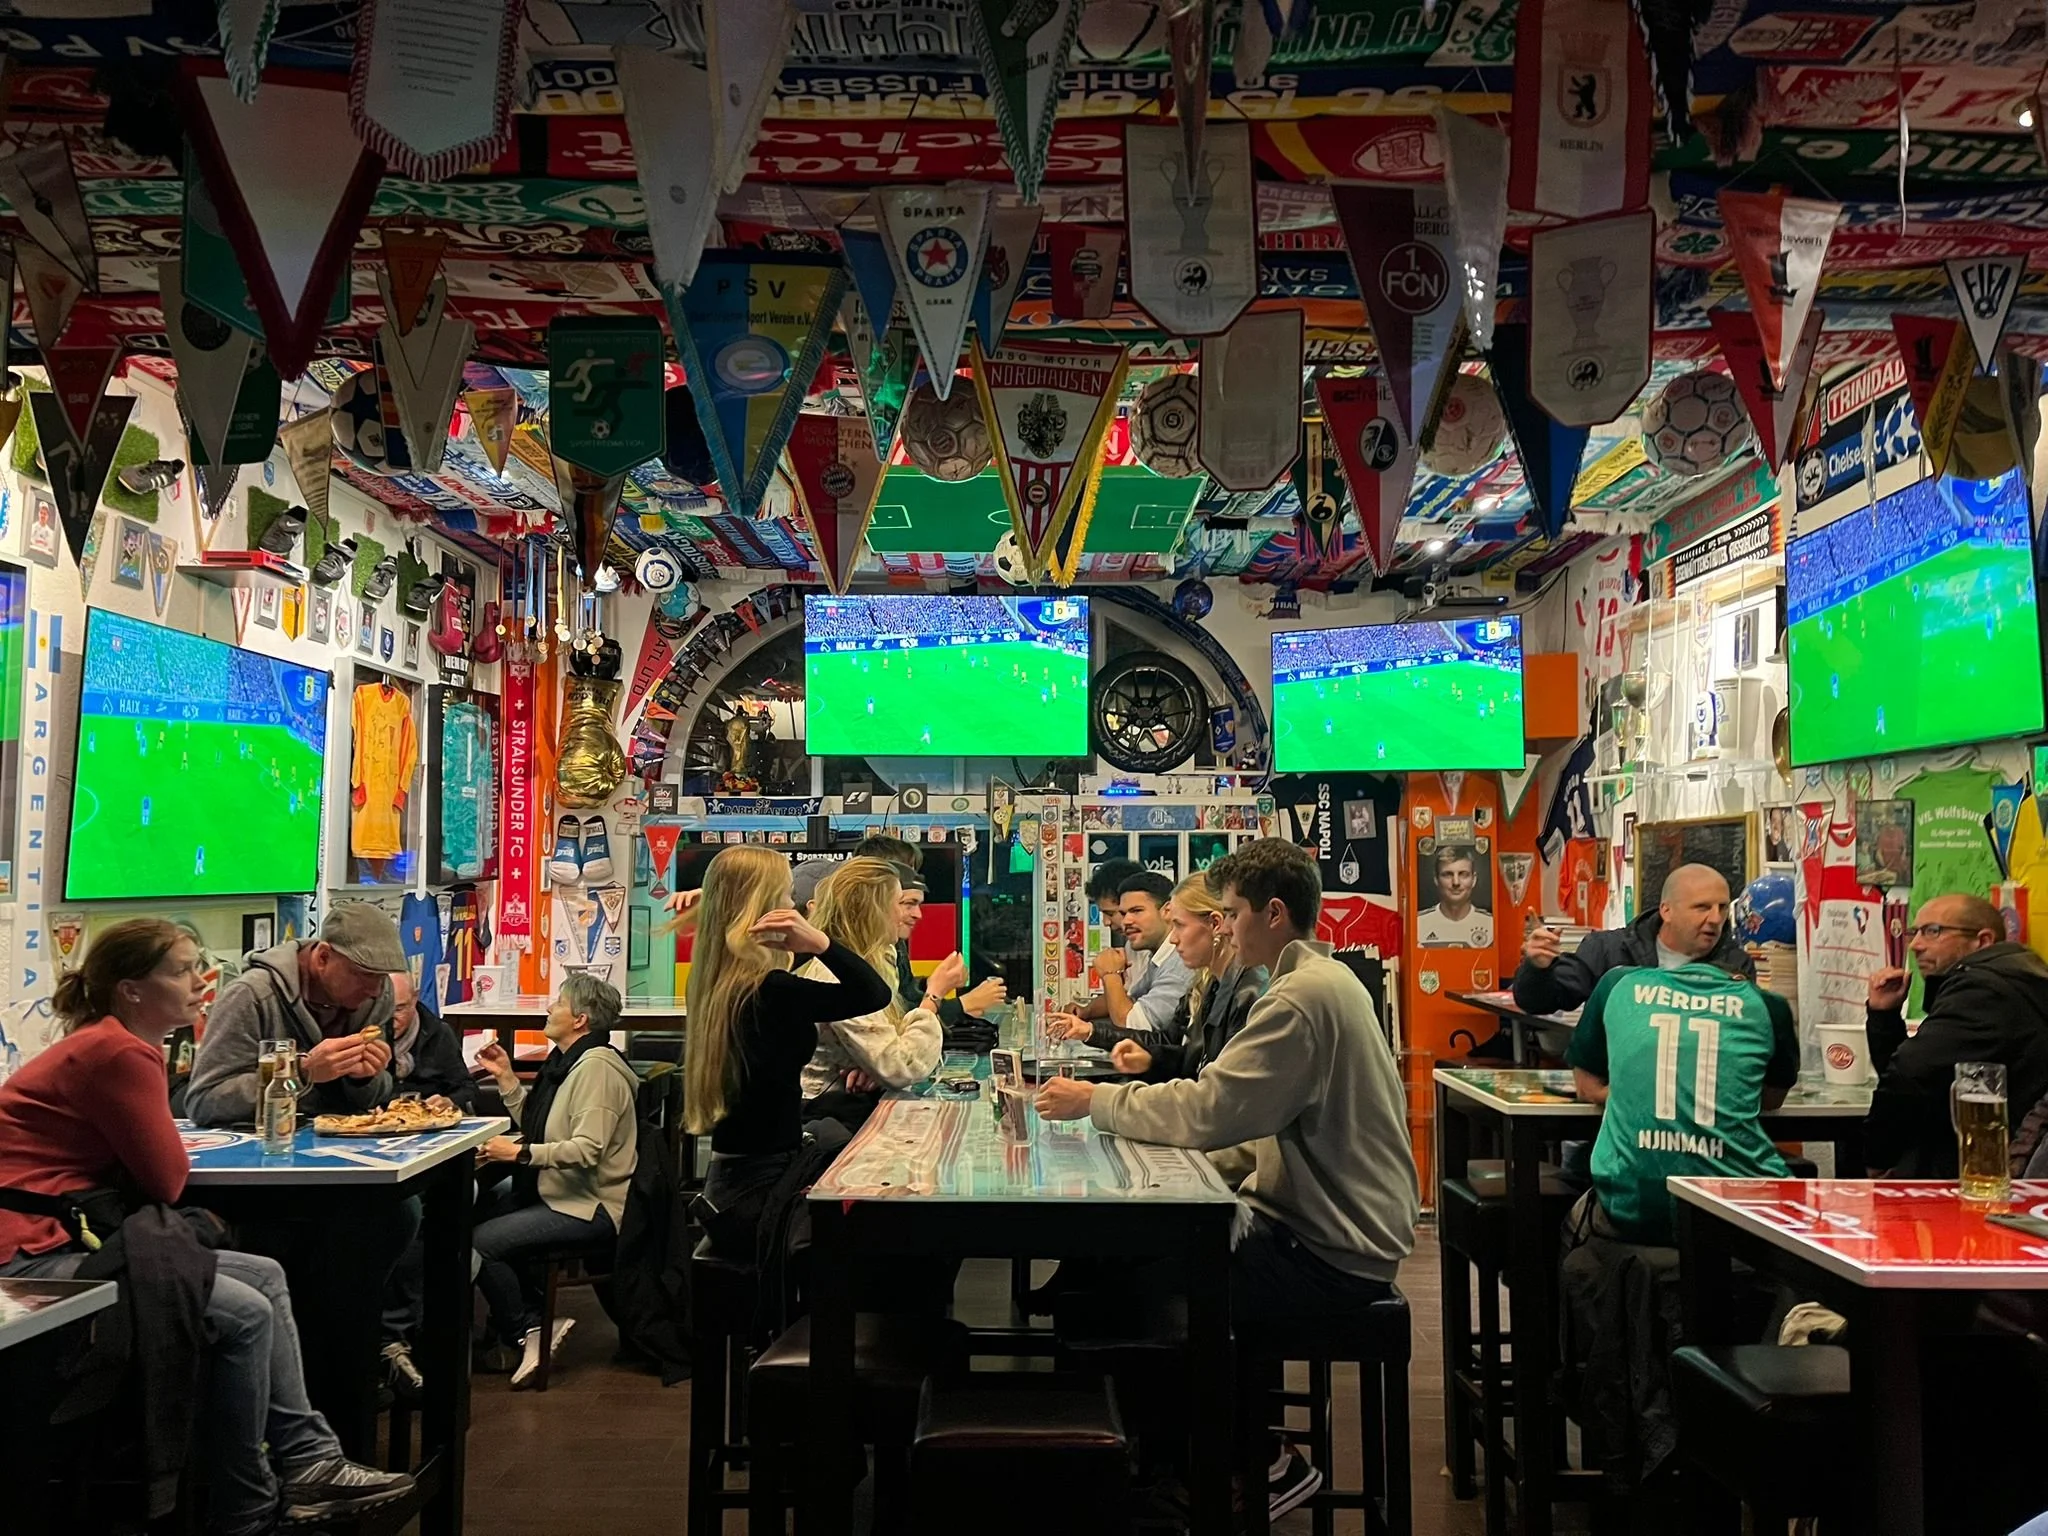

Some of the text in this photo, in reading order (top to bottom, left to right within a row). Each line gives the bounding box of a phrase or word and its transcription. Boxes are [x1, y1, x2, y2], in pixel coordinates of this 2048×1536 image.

[1559, 139, 1604, 152] BERLIN
[903, 206, 966, 218] SPARTA
[908, 228, 963, 253] SPARTA
[1385, 270, 1440, 298] FCN
[1962, 262, 2012, 300] FIFA
[769, 311, 796, 325] Verein
[996, 350, 1101, 369] BSG MOTOR
[990, 365, 1103, 395] NORDHAUSEN
[1829, 358, 1907, 419] TRINIDAD
[802, 434, 873, 450] MÜNCHEN
[820, 426, 872, 441] BAYERN
[632, 637, 667, 696] ATL UTD
[510, 719, 527, 859] STRALSUNDER FC
[655, 788, 672, 799] sky
[725, 805, 803, 816] DARMSTADT 98
[1318, 783, 1332, 861] SSC NAPOLI
[1934, 805, 1986, 828] Wolfsburg
[22, 682, 49, 989] ARGENTINA
[453, 926, 474, 981] 11
[1634, 984, 1745, 1019] WERDER
[1649, 1013, 1721, 1128] 11
[1638, 1129, 1724, 1160] NJINMAH
